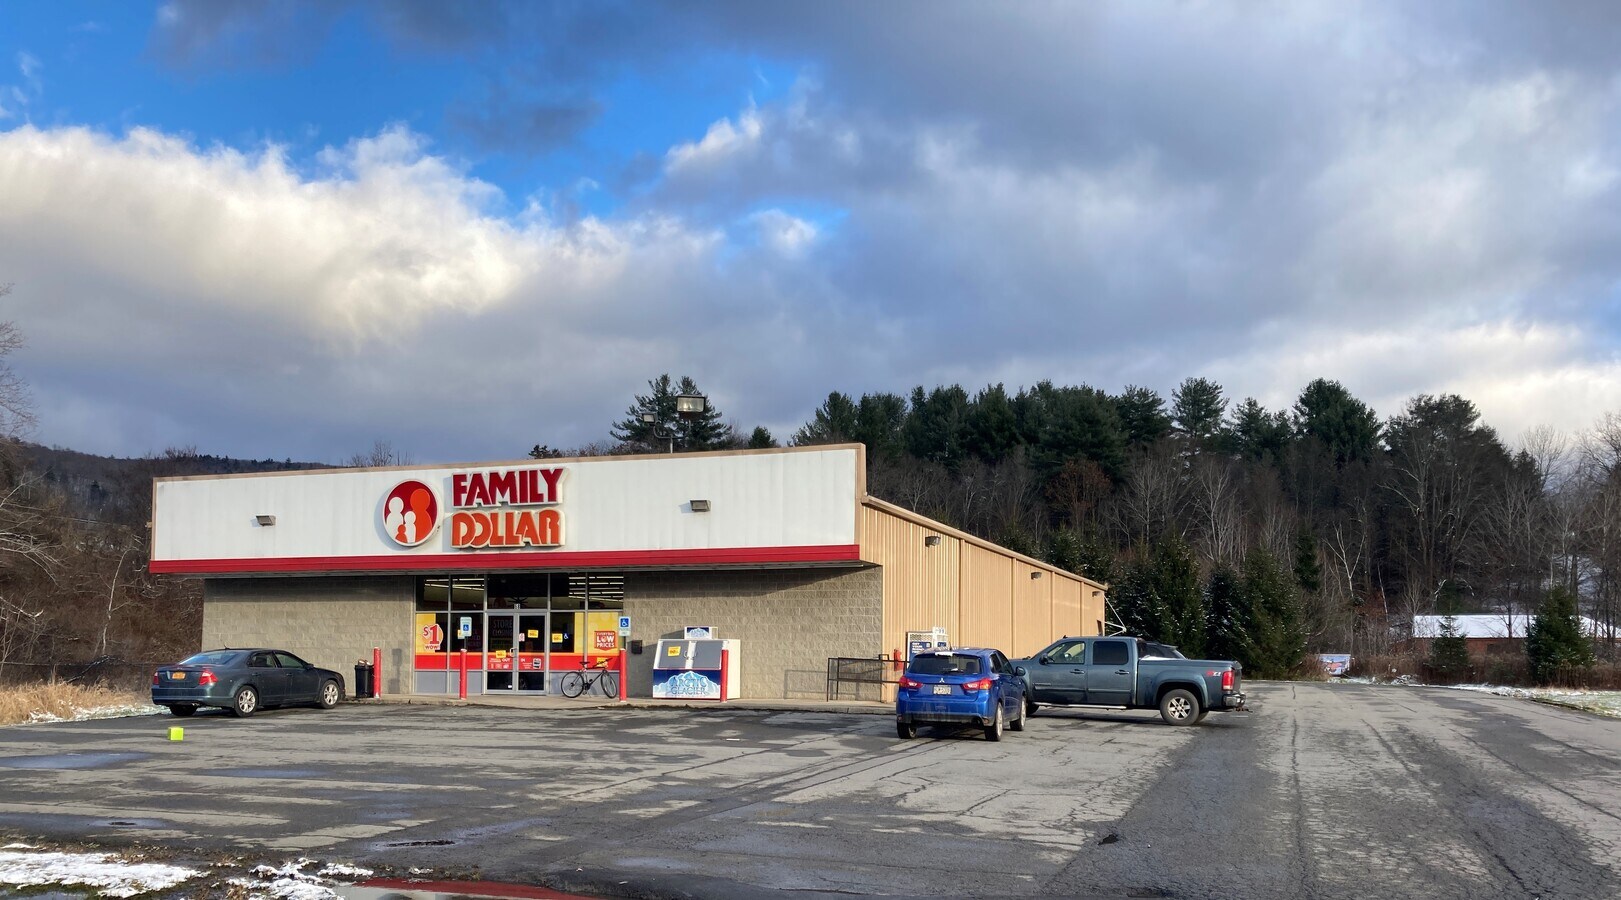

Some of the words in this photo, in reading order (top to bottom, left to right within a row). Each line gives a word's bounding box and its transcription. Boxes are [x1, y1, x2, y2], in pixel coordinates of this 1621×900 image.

[453, 468, 564, 507] FAMILY
[452, 509, 560, 546] DOLLAR
[423, 625, 439, 644] $1
[670, 677, 707, 687] ARCTIC
[671, 687, 706, 695] GLACIER
